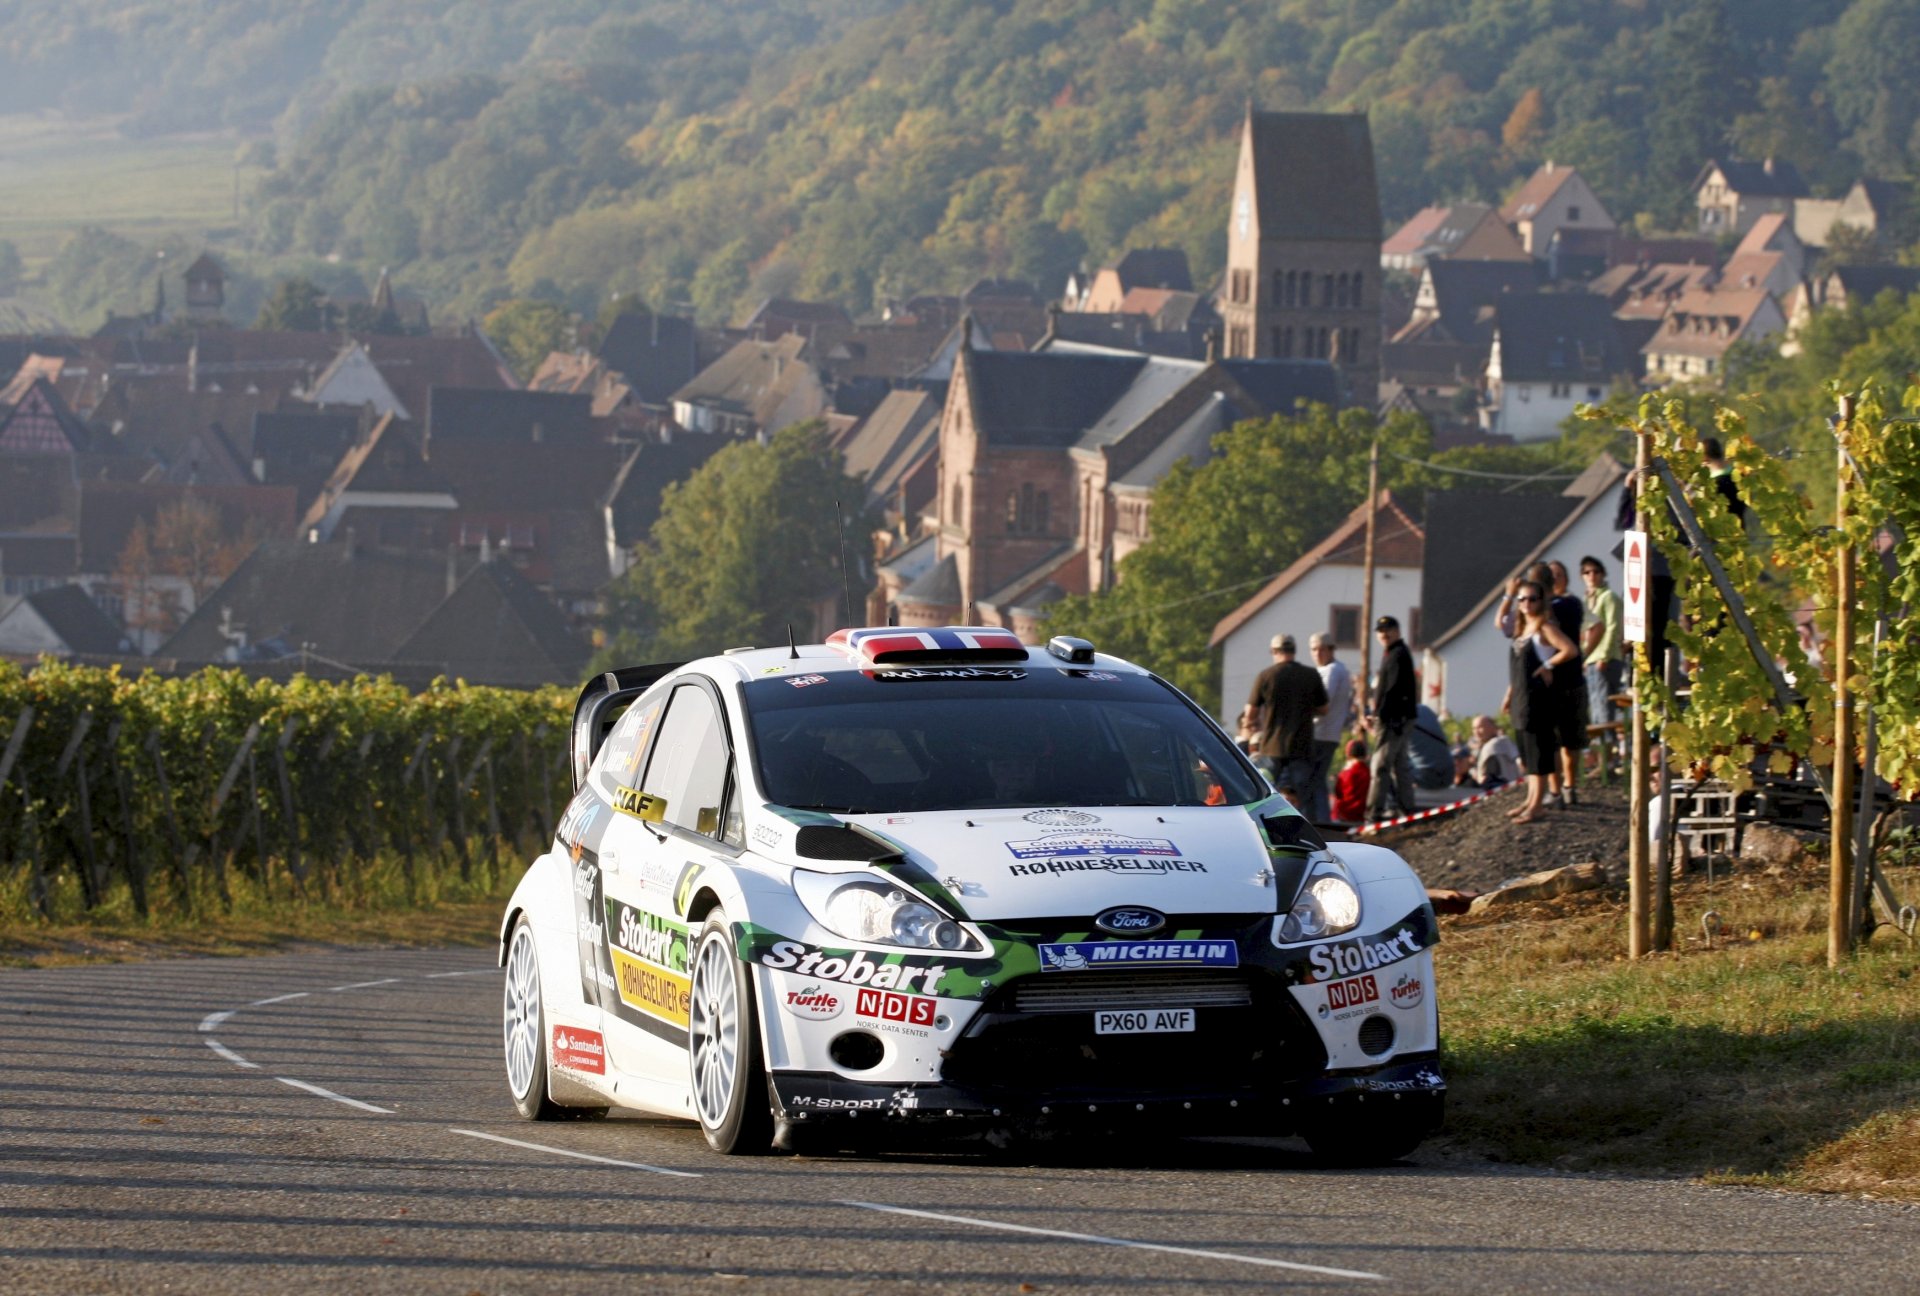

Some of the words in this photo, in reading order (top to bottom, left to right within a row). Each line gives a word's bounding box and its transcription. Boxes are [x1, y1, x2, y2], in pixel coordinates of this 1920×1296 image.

[613, 789, 654, 815] NAF
[1099, 838, 1154, 846] Mutuel
[1008, 859, 1209, 876] RØHNESELMER
[678, 864, 700, 918] 6
[1112, 911, 1150, 928] Ford
[619, 905, 673, 967] Stobart
[1092, 944, 1227, 960] MICHELIN
[1309, 927, 1423, 981] Stobart
[762, 940, 946, 996] Stobart
[786, 991, 838, 1008] Turtle
[1329, 977, 1377, 1007] NDS
[1390, 978, 1421, 1001] Turtle
[858, 990, 932, 1022] NDS
[856, 1020, 880, 1031] NORSK
[881, 1024, 900, 1034] DATA
[901, 1027, 929, 1038] SENTER
[1100, 1012, 1148, 1032] PX60
[1154, 1011, 1191, 1030] AVF
[569, 1035, 603, 1056] Santander
[791, 1095, 886, 1109] M-SPORT
